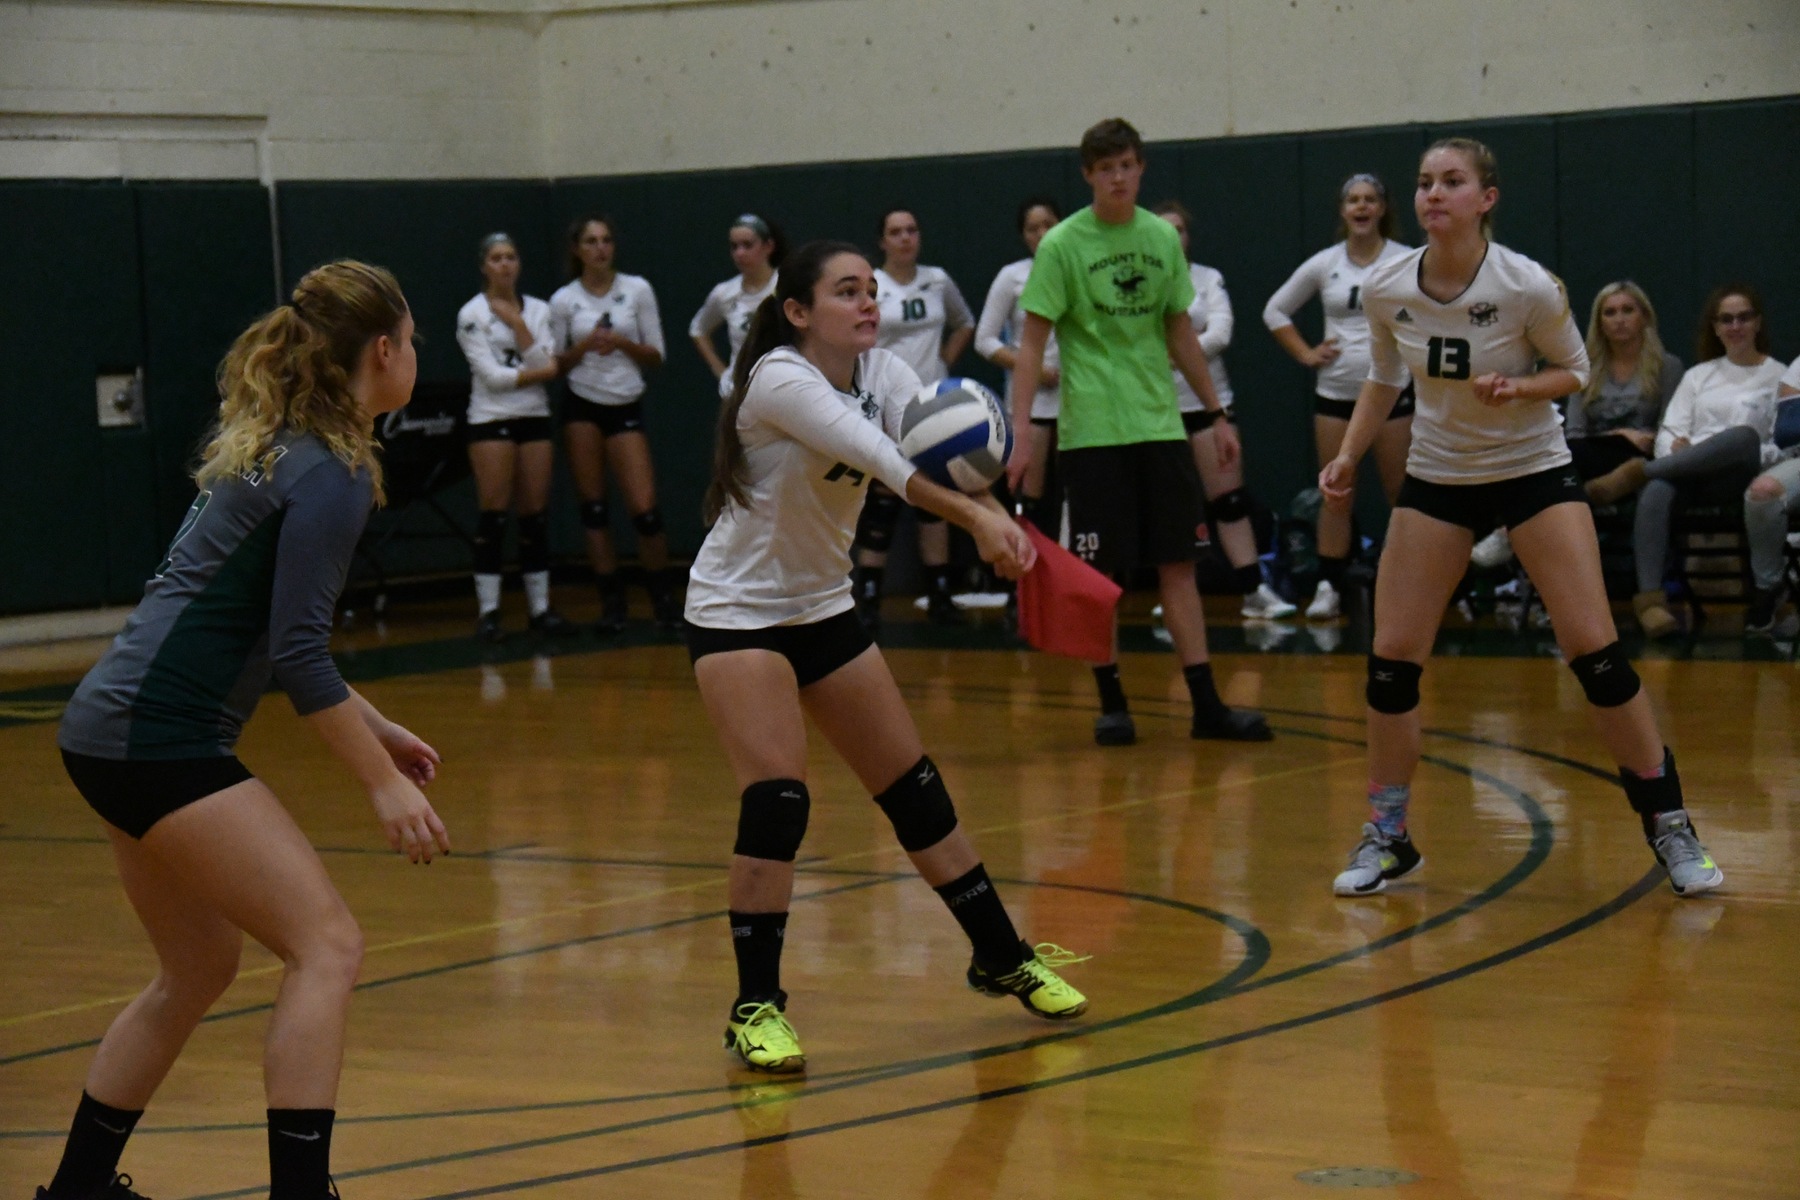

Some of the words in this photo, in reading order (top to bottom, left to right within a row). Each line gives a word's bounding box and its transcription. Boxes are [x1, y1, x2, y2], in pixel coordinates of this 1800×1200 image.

[1088, 252, 1135, 273] MOUNT
[902, 298, 926, 321] 10
[1427, 335, 1471, 380] 13
[1075, 531, 1100, 551] 20
